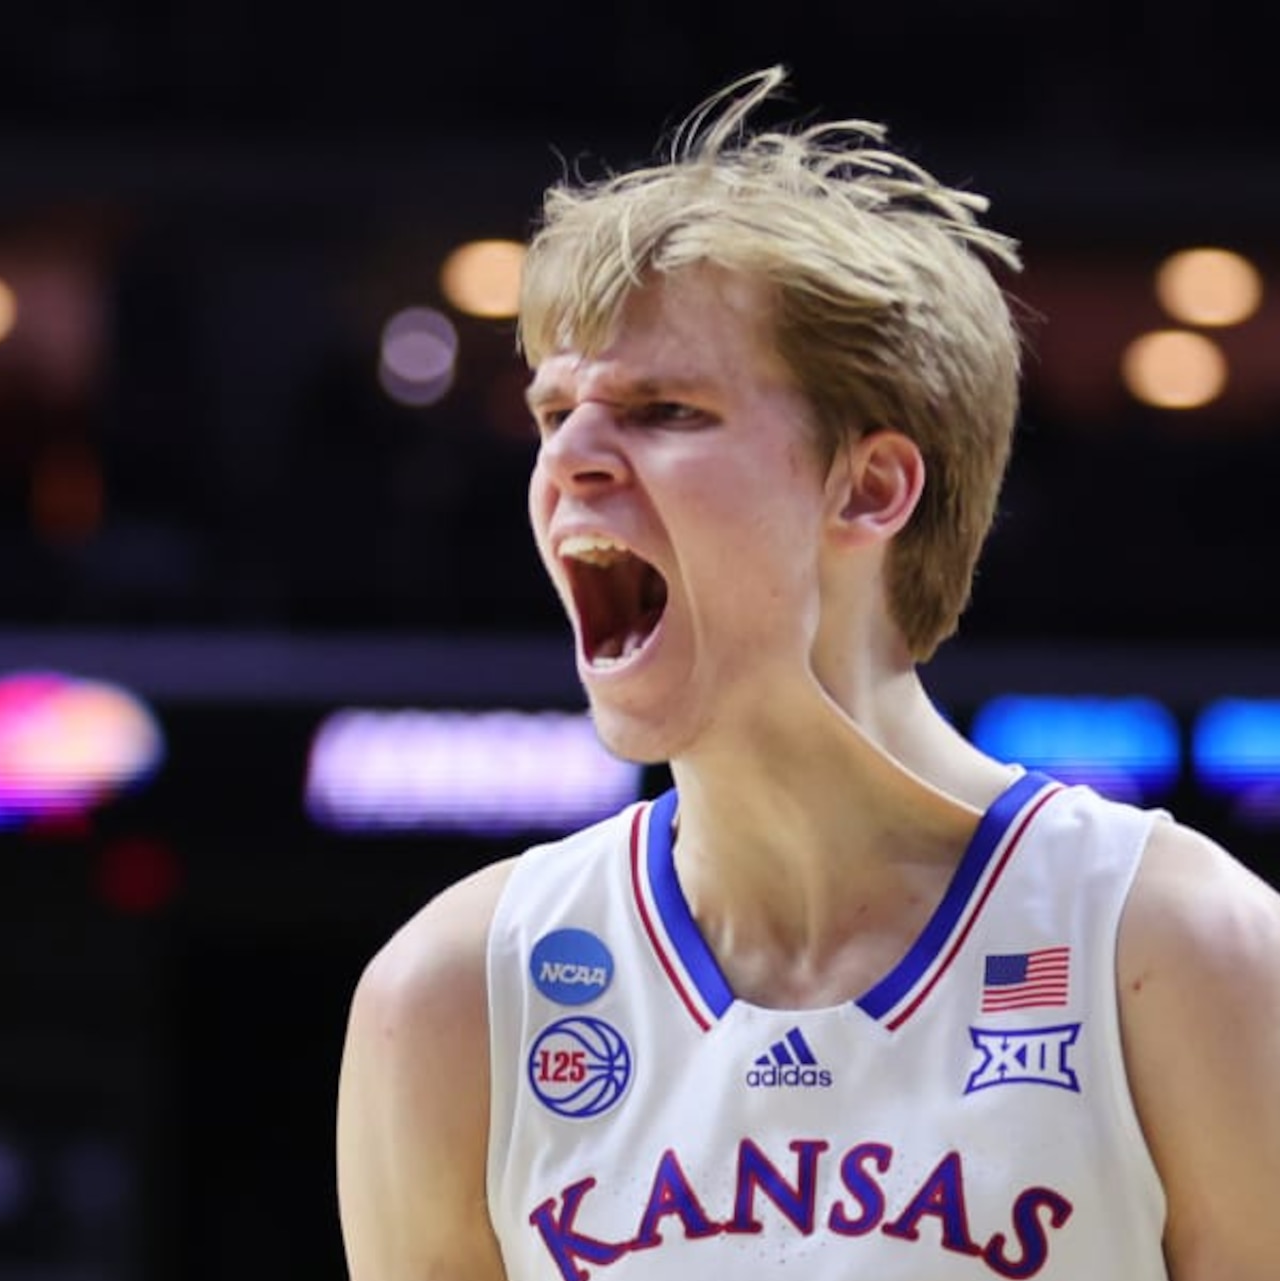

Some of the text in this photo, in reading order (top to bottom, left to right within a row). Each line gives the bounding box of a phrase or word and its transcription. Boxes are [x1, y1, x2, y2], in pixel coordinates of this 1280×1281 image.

[539, 961, 607, 986] NCAA
[538, 1049, 586, 1082] 125
[964, 1022, 1082, 1095] XII
[746, 1064, 833, 1087] adidas
